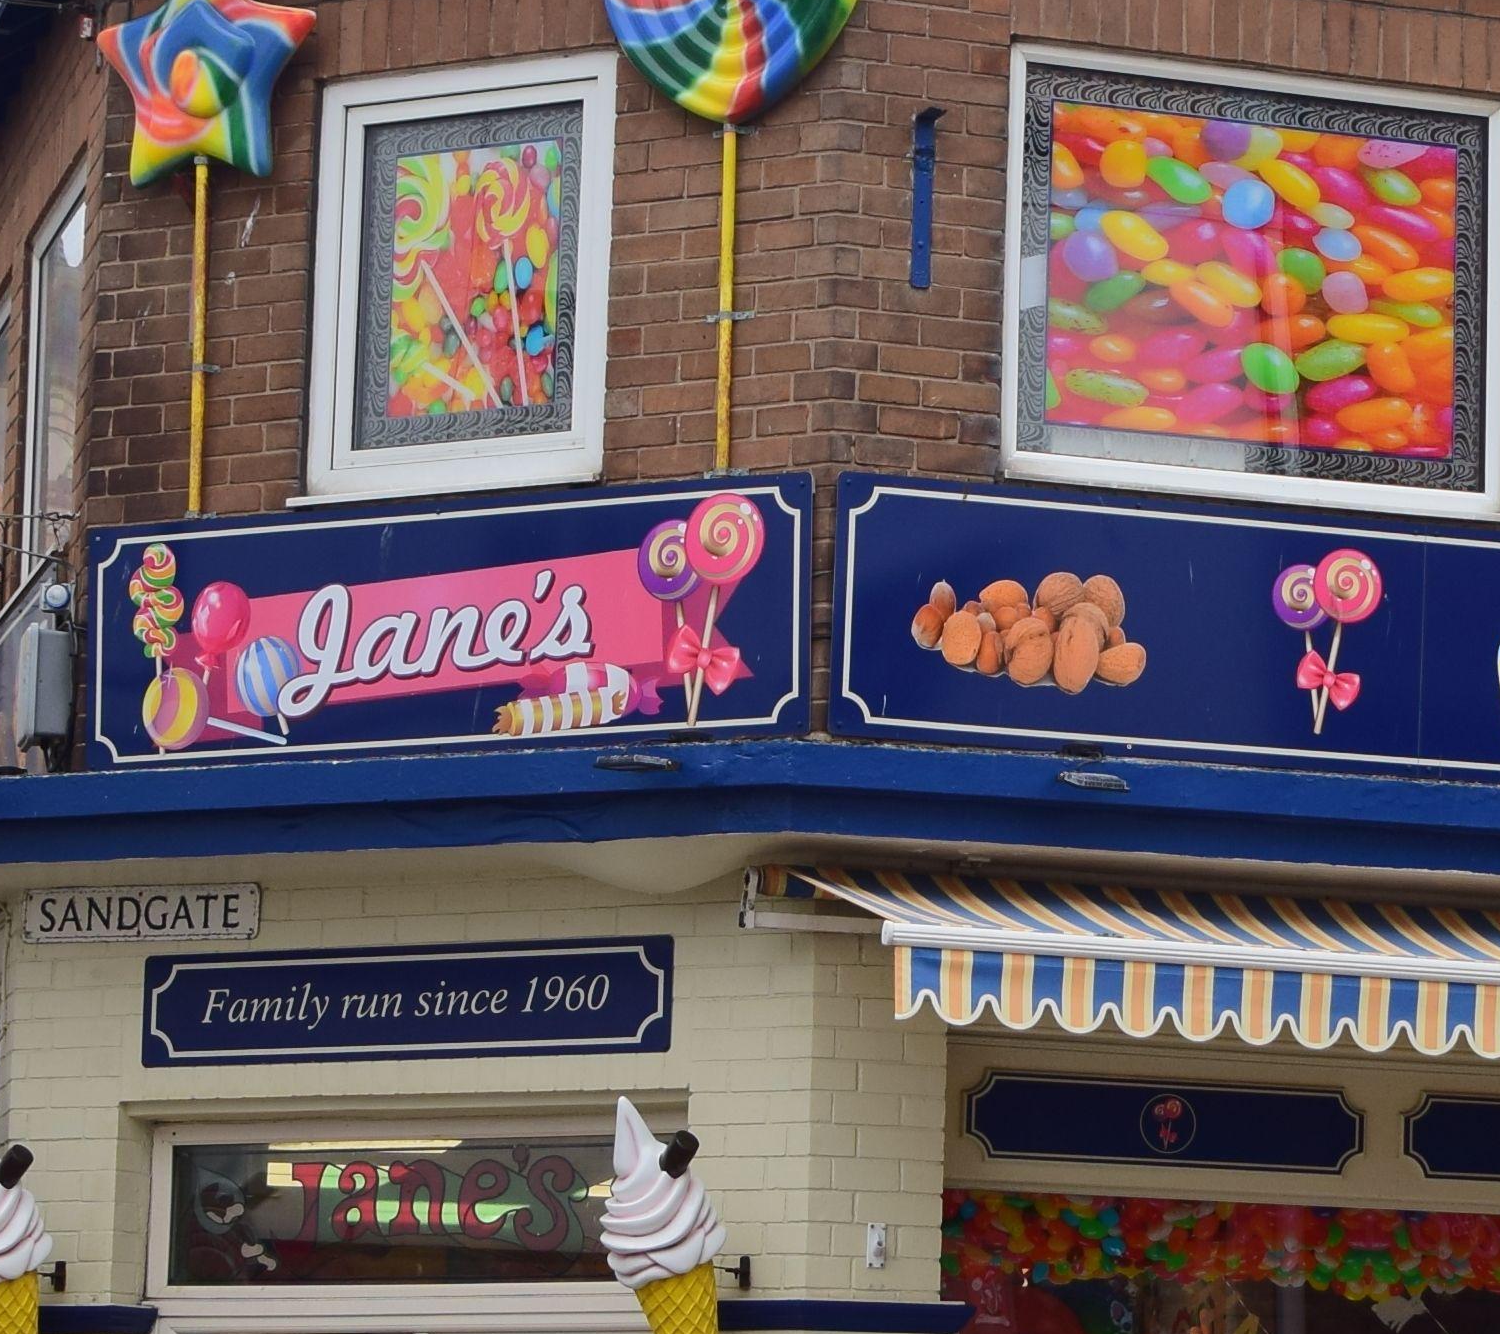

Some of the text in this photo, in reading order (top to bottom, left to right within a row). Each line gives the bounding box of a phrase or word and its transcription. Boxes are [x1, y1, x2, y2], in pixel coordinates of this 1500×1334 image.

[277, 568, 596, 720] Jane's
[38, 893, 241, 933] SANDGATE
[202, 974, 611, 1030] Family run since 1960
[275, 1144, 577, 1269] Jane's
